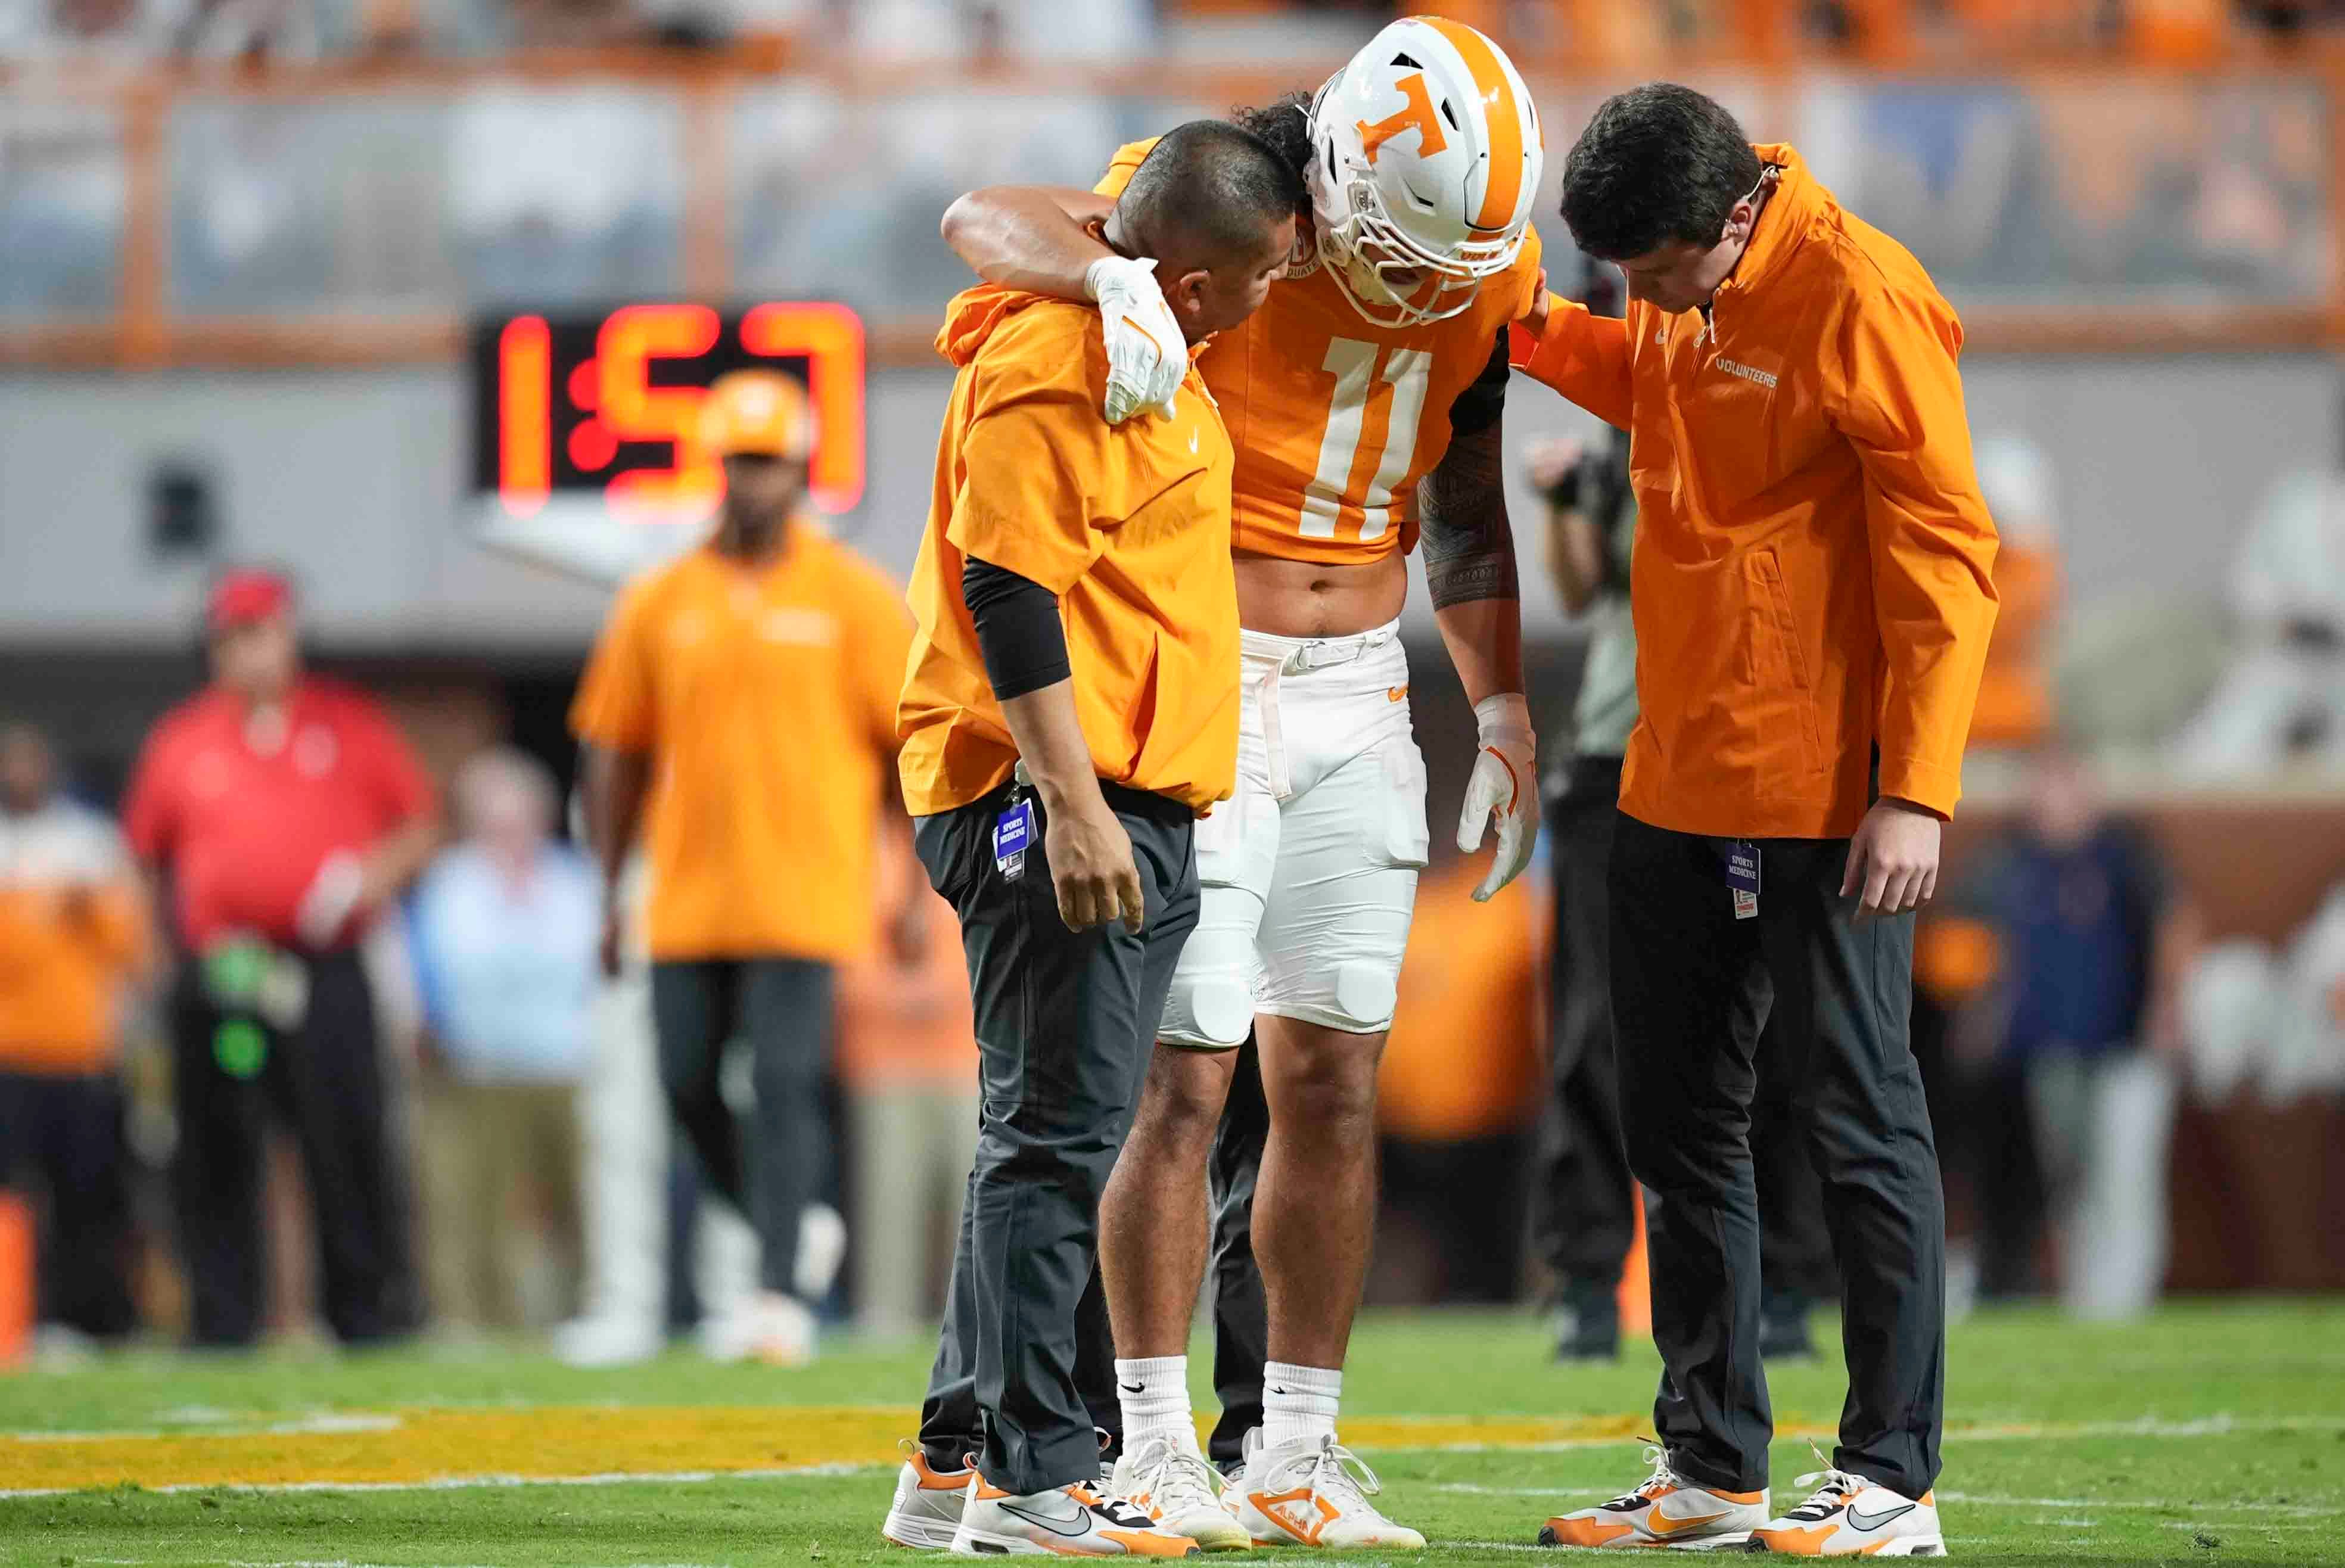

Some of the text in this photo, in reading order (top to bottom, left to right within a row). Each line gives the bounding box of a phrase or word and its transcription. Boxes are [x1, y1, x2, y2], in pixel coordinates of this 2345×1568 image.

[1716, 357, 1777, 388] VOLUNTEERS
[499, 301, 865, 525] 1:57
[1298, 335, 1432, 542] 11
[1728, 864, 1756, 879] MEDICINE
[1732, 855, 1753, 868] SPORTS
[1274, 1505, 1310, 1535] ALPHA
